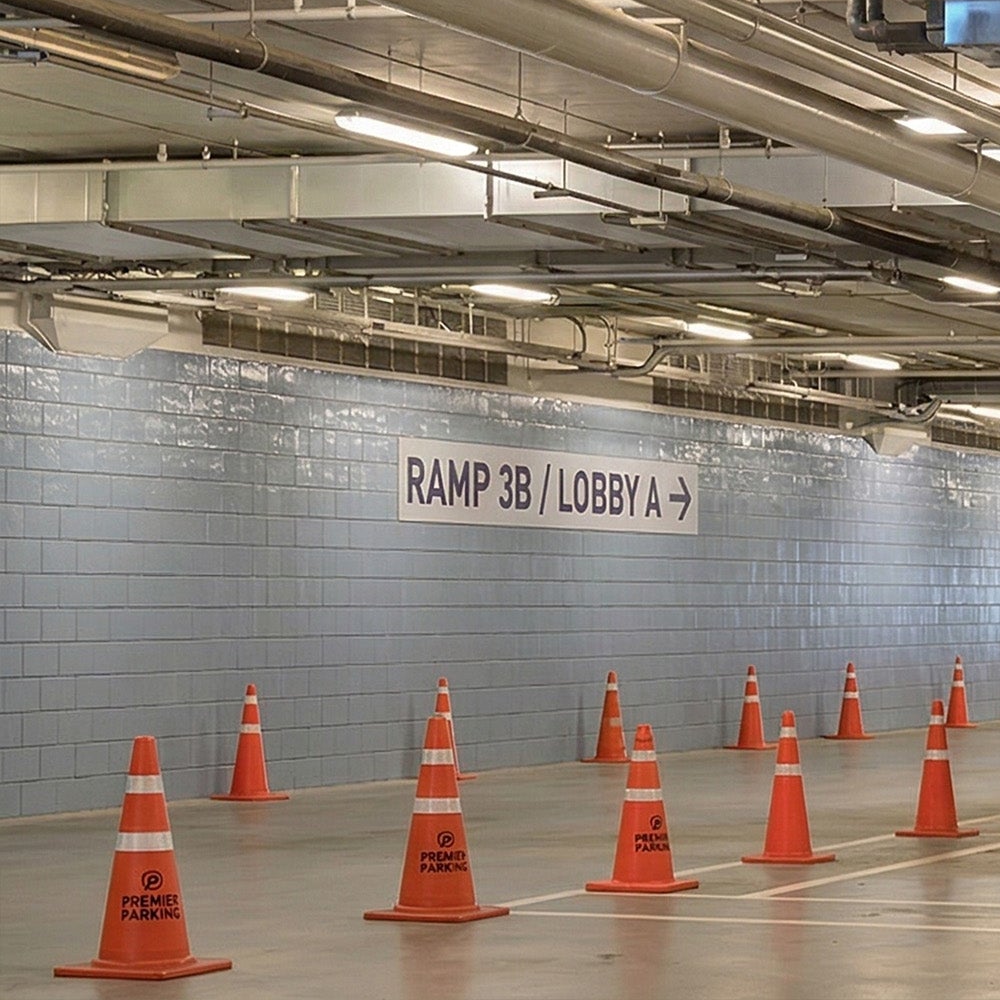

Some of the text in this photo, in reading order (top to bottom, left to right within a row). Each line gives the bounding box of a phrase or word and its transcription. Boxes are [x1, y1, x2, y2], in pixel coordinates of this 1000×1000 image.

[407, 456, 662, 518] RAMP 3B / LOBBY A
[122, 894, 179, 908] PREMIER
[121, 907, 180, 921] PARKING
